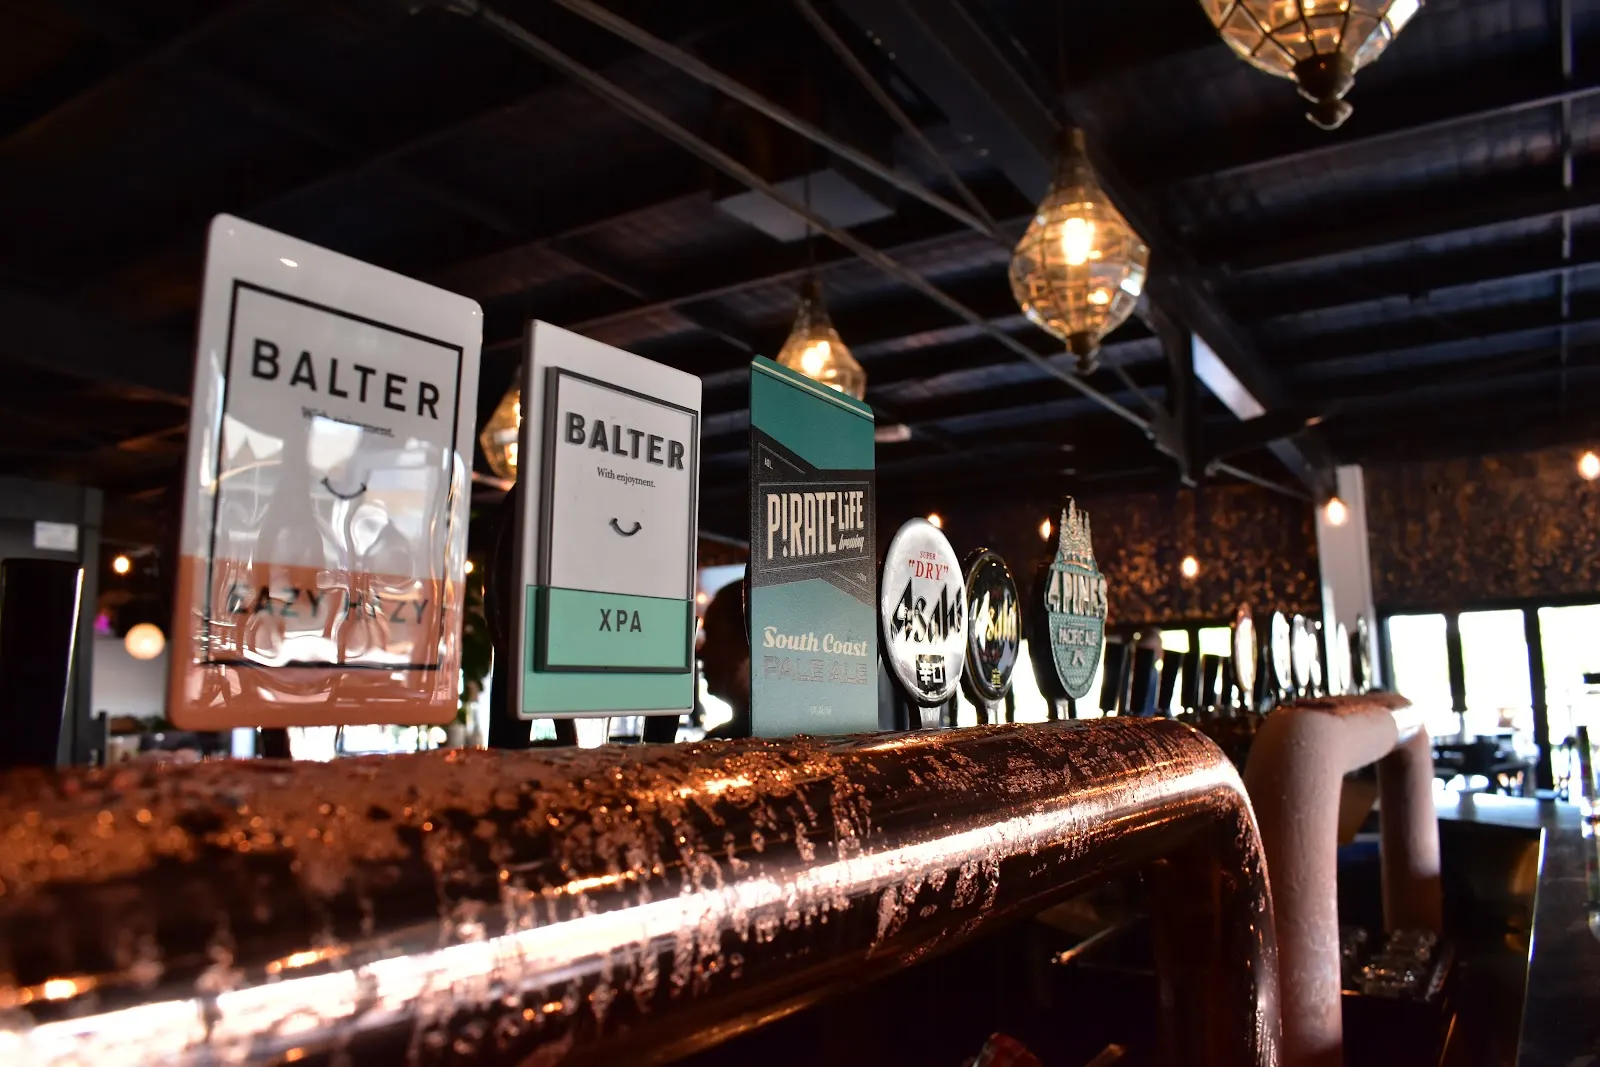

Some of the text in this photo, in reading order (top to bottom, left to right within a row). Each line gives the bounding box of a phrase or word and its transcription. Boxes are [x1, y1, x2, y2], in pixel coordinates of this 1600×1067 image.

[251, 337, 441, 421] BALTER
[564, 410, 686, 471] BALTER
[596, 466, 656, 488] With enjoyment.
[919, 550, 937, 561] SUPER
[598, 607, 642, 633] XPA
[762, 625, 869, 657] South Coast
[763, 655, 868, 685] PALE ALE
